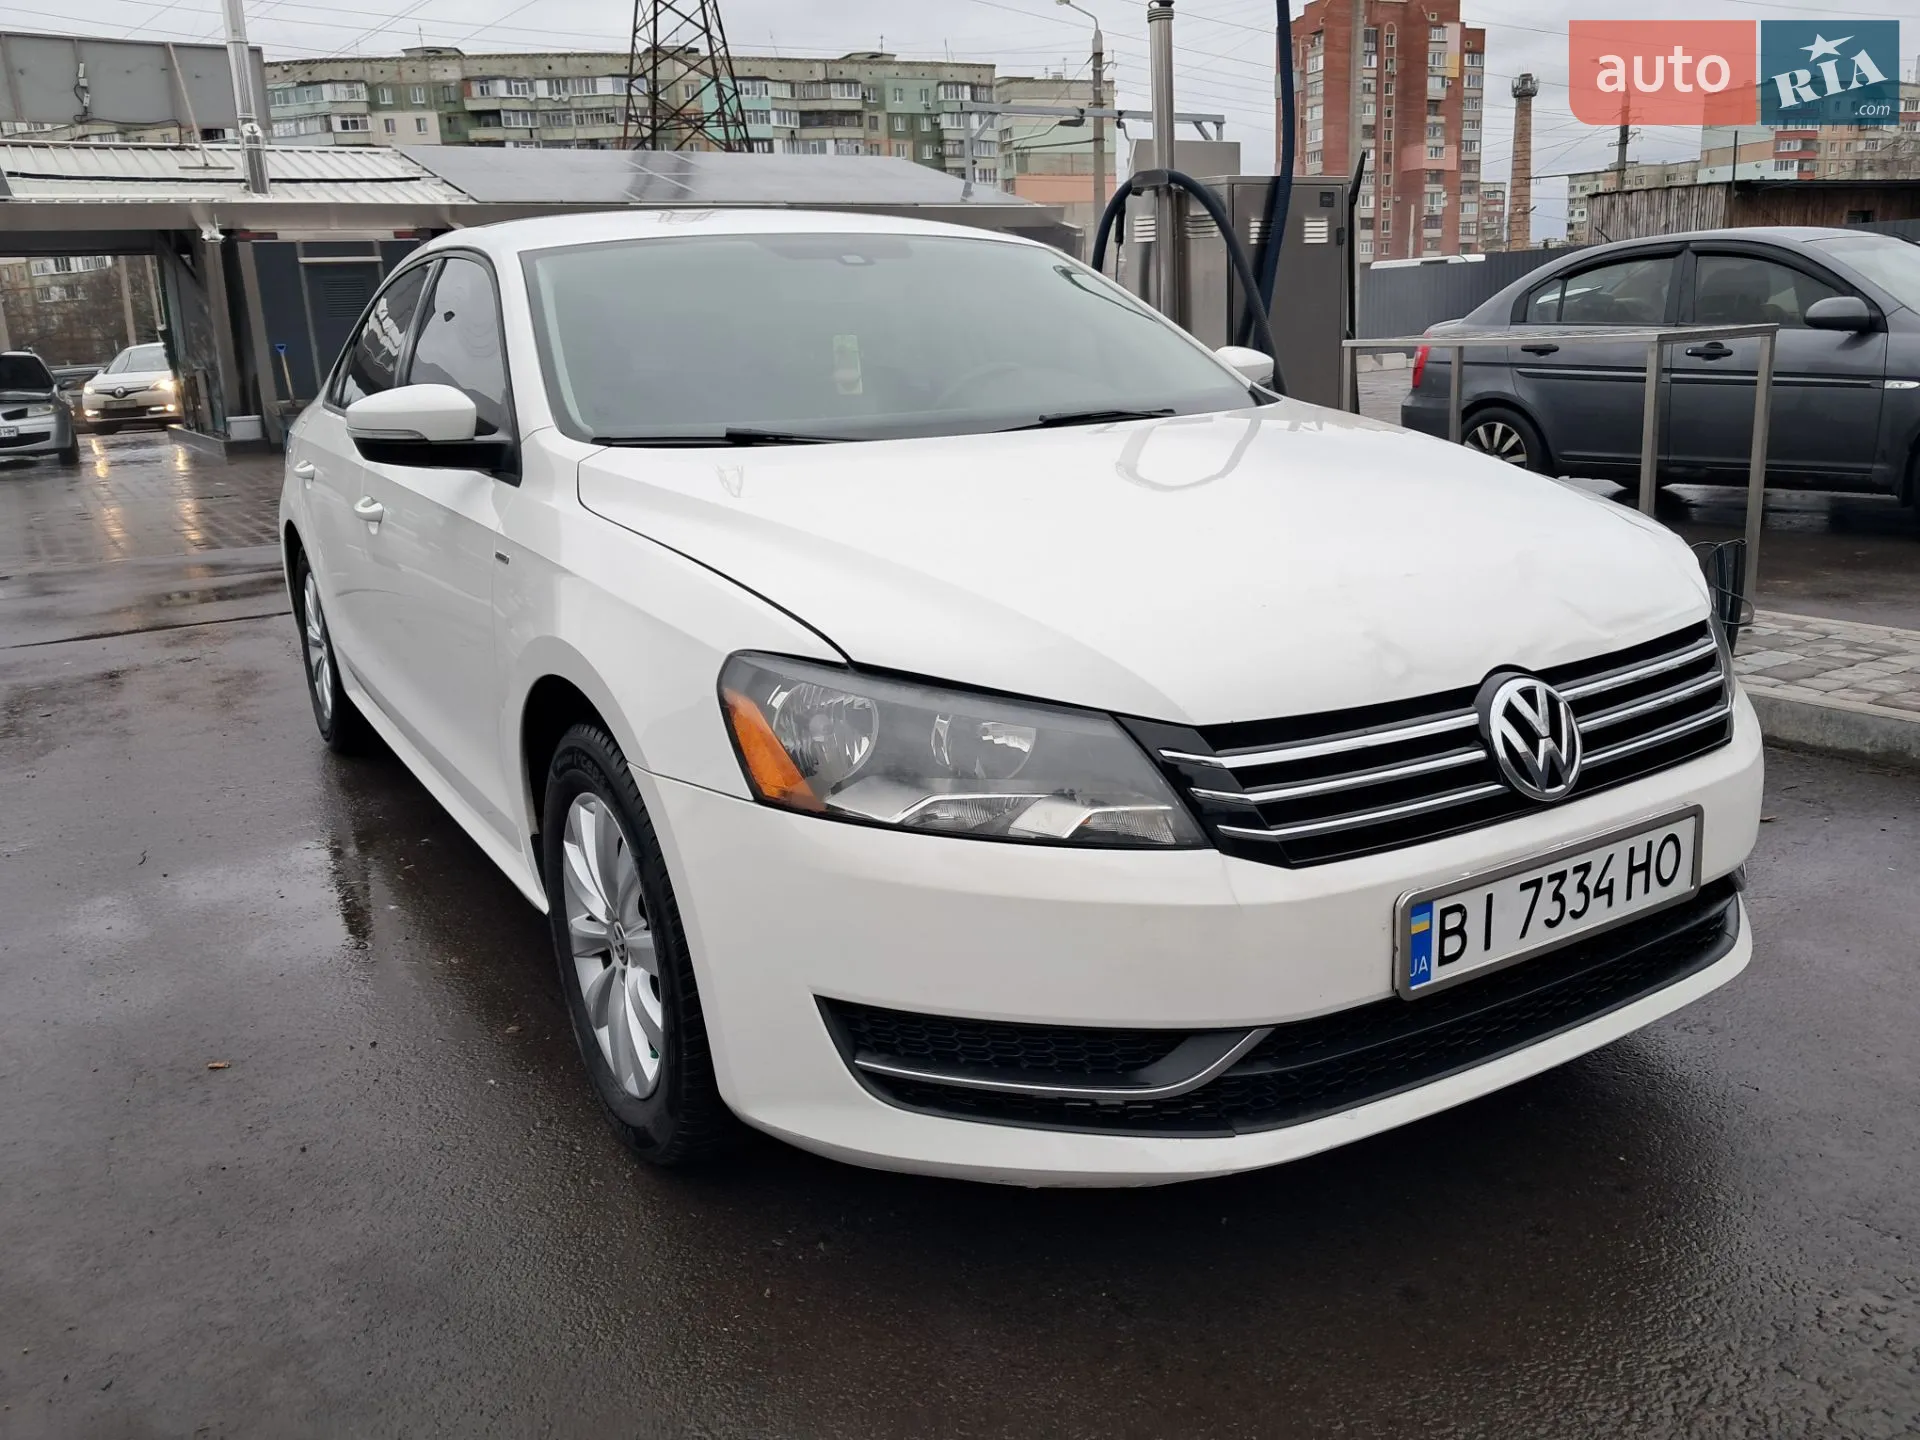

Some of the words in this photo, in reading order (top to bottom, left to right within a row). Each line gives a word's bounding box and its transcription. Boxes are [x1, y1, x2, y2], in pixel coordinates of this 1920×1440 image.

[1437, 892, 1494, 967] BI
[1519, 852, 1615, 940] 7334
[1625, 832, 1682, 902] HO
